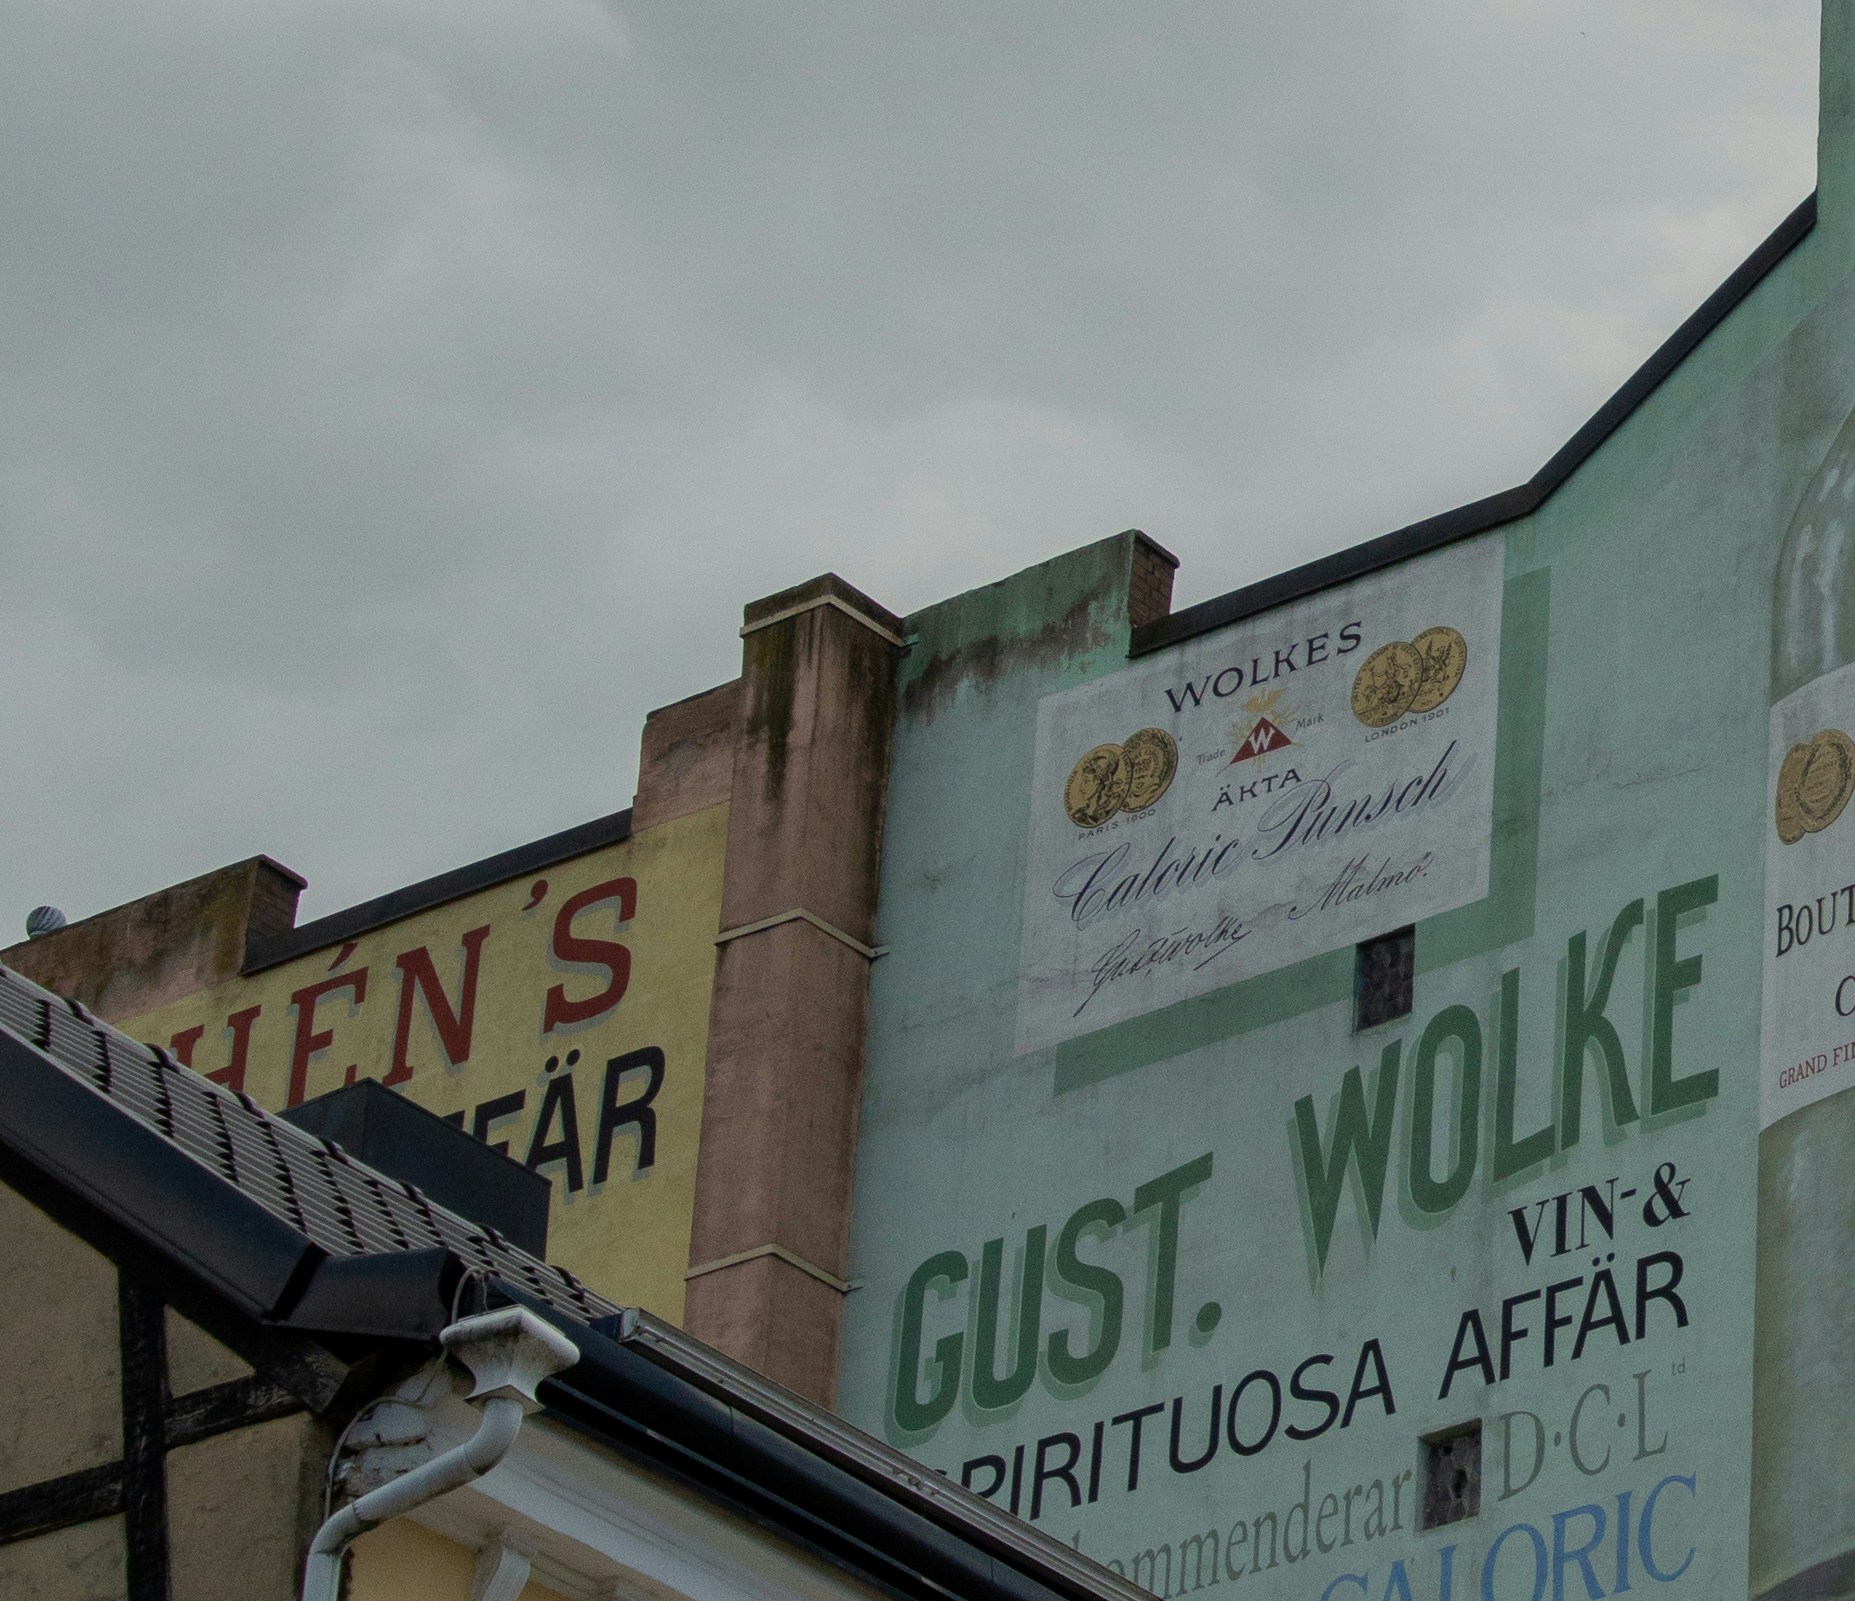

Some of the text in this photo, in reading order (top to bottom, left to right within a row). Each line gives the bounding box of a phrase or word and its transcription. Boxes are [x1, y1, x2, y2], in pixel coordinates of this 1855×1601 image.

[1164, 620, 1363, 714] WOLKES
[1248, 725, 1276, 755] W
[1296, 712, 1325, 731] Mark
[1365, 707, 1450, 742] LONDON 1901
[1196, 748, 1226, 767] Trade
[1211, 768, 1302, 812] ÄKTA
[1052, 836, 1239, 930] Caloric
[1251, 740, 1457, 860] Punsch
[1077, 807, 1157, 841] PARIS 1900
[1287, 873, 1720, 1292] WOLKE
[1778, 1053, 1828, 1090] GRAND
[932, 1250, 1689, 1522] PIRITUOSA AFFÄR
